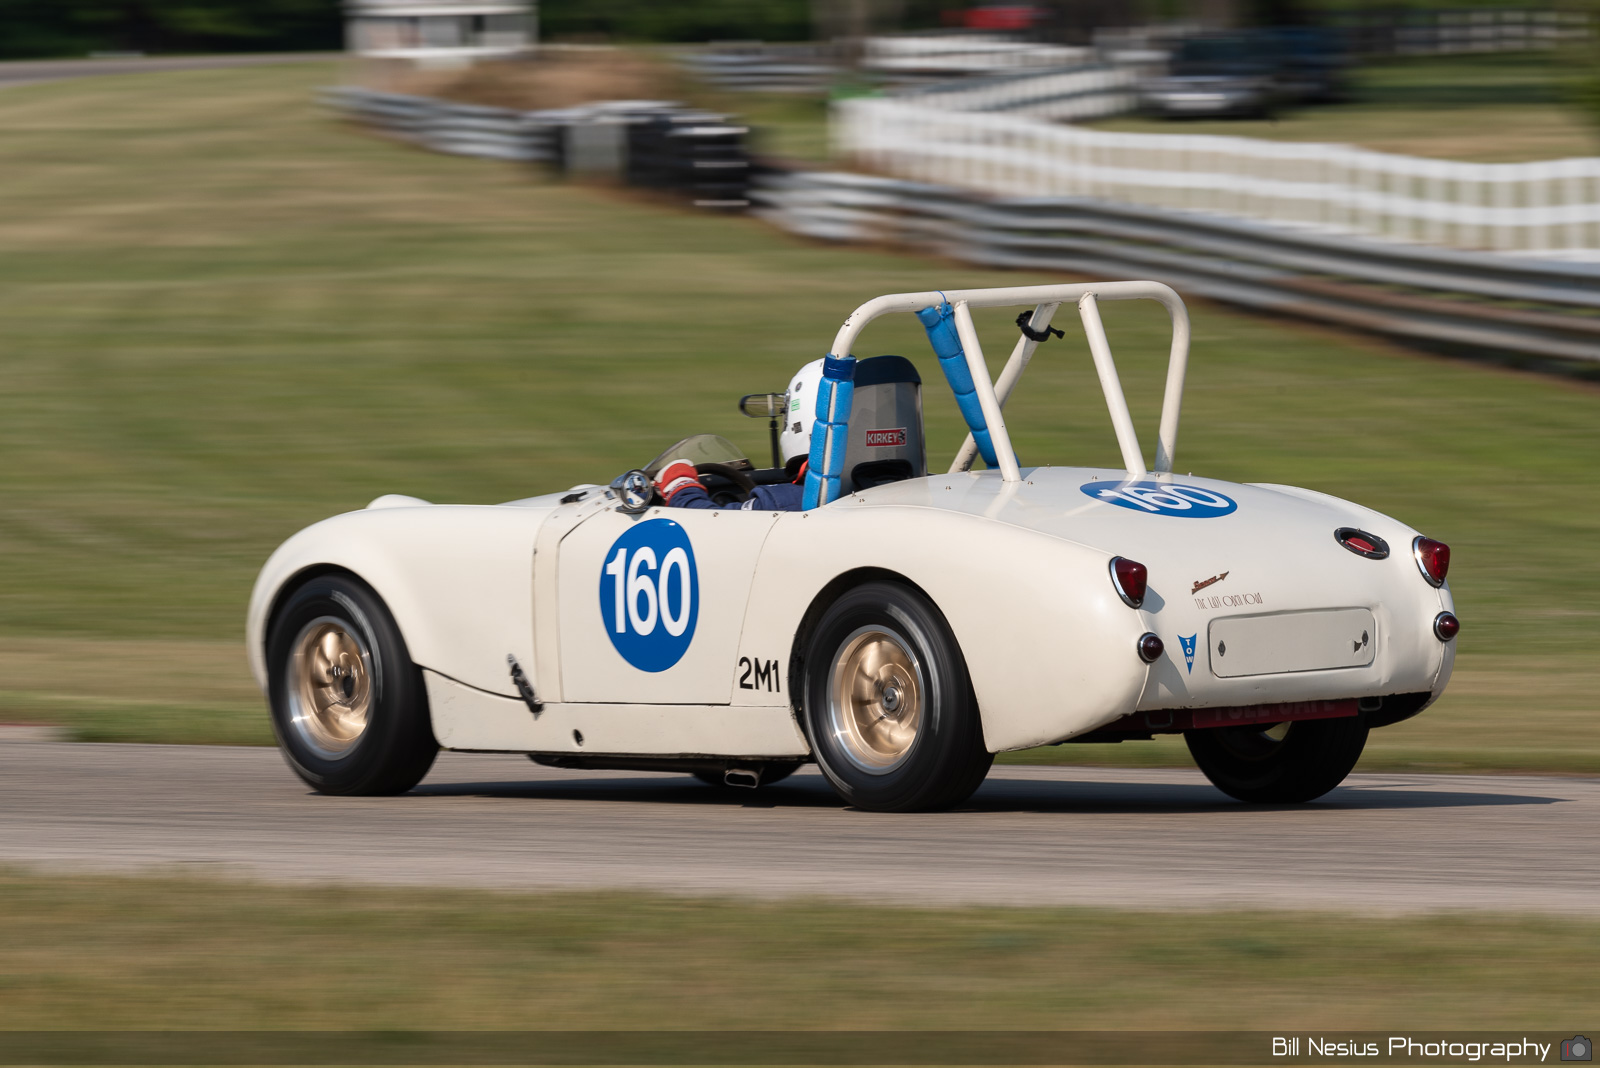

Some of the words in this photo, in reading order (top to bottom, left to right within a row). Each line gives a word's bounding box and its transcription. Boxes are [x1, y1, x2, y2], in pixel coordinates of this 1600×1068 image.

[867, 430, 899, 445] KIRKEY
[1097, 485, 1230, 511] 160
[606, 546, 691, 637] 160
[1185, 638, 1194, 664] TOW
[738, 656, 780, 692] 2M1
